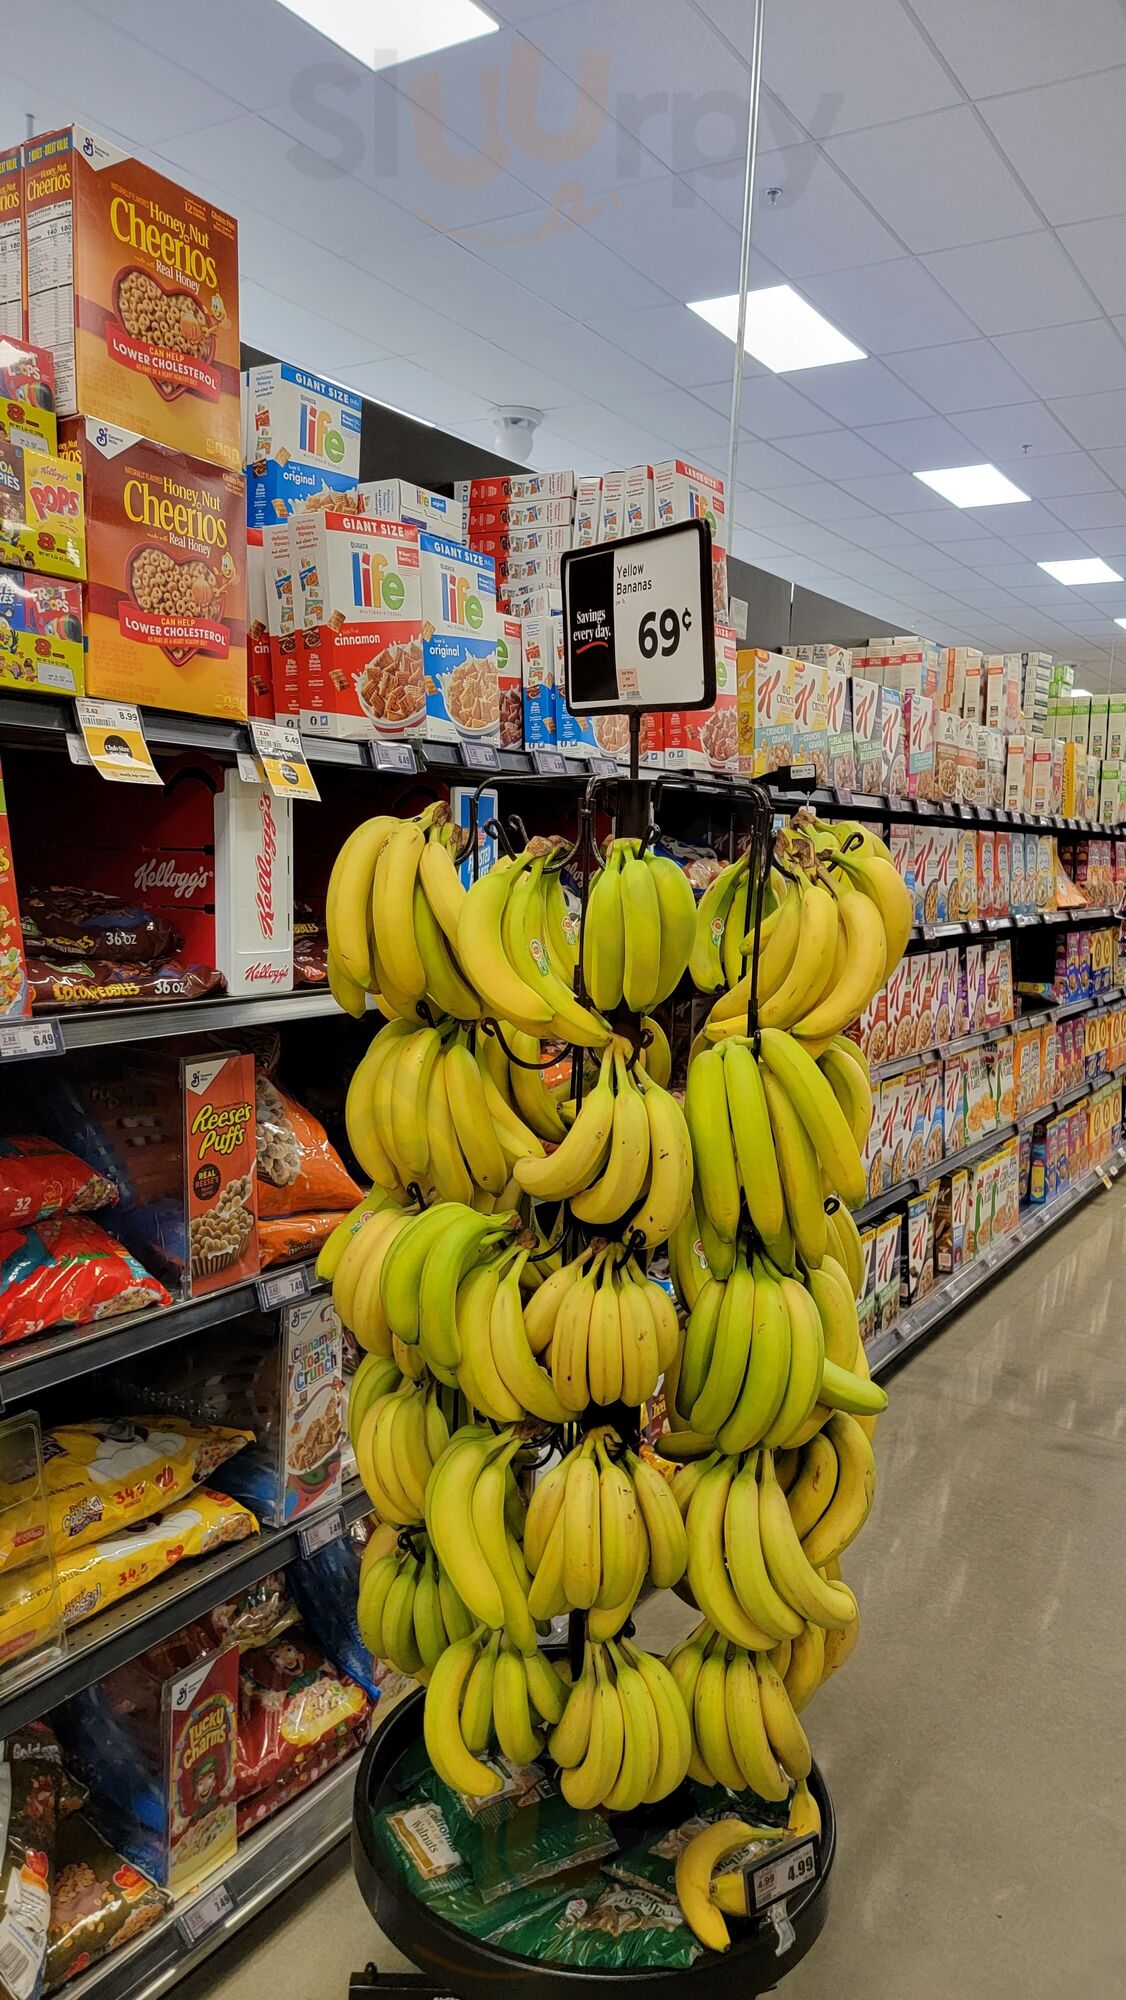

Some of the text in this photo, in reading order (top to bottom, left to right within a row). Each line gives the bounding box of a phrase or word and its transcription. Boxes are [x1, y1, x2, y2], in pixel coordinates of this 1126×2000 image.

[57, 162, 67, 174] Nut
[28, 172, 71, 202] Cheerios
[53, 200, 72, 211] Facts
[150, 200, 210, 250] Honey Nut
[110, 196, 218, 289] Cheerios
[156, 259, 200, 295] Real Honey
[112, 338, 218, 390] LOWER CHOLESTEROL
[150, 346, 185, 362] CAN HELP
[8, 363, 41, 381] LOOPS
[296, 373, 326, 394] GIANT
[328, 388, 349, 404] SIZE
[7, 402, 26, 424] 8
[300, 402, 345, 464] life
[40, 465, 70, 481] Kellogg's
[283, 470, 316, 486] original
[29, 484, 80, 522] POPS
[163, 476, 221, 512] Honey Nut
[124, 479, 228, 548] Cheerios
[37, 532, 56, 551] 8
[343, 518, 404, 538] GIANT SIZE
[169, 532, 211, 558] Real Honey
[350, 542, 369, 550] QUAKER
[434, 541, 484, 566] GIANT SIZE
[352, 551, 406, 611] life
[616, 563, 644, 579] Yellow
[440, 571, 484, 630] life
[616, 579, 652, 596] Bananas
[36, 598, 70, 614] LOOPS
[576, 608, 606, 625] Savings
[124, 617, 226, 646] LOWER CHOLESTEROL
[160, 618, 196, 627] CAN HELP
[573, 622, 612, 643] every day.
[638, 606, 692, 660] 69¢
[35, 638, 52, 658] 8
[334, 632, 381, 647] cinnamon
[429, 644, 460, 658] original
[758, 670, 781, 720] K
[794, 678, 816, 726] K
[118, 711, 138, 721] 8.99
[856, 690, 875, 740] K
[284, 735, 300, 744] 6.49
[883, 708, 899, 754] K
[913, 711, 928, 751] K
[134, 859, 208, 898] Kellogg's
[256, 790, 276, 940] Kellogg's
[106, 932, 122, 946] 36
[124, 933, 138, 946] OZ
[244, 960, 289, 985] Kellogg's
[154, 982, 186, 994] 36 OZ
[33, 1034, 54, 1046] 6.49
[924, 1079, 938, 1122] K
[946, 1071, 960, 1113] K
[191, 1104, 253, 1136] Reese's
[882, 1096, 900, 1149] K
[903, 1087, 920, 1132] K
[198, 1124, 246, 1161] Puffs
[195, 1177, 219, 1188] REESE'S
[198, 1169, 216, 1180] REAL
[14, 1196, 32, 1211] 32
[954, 1181, 966, 1223] K
[912, 1217, 927, 1260] K
[878, 1234, 896, 1283] K
[24, 1319, 44, 1334] 32
[292, 1328, 337, 1364] Cinnamon
[300, 1343, 331, 1371] Toast
[294, 1352, 338, 1392] Crunch
[69, 1496, 88, 1512] Berry
[113, 1480, 146, 1506] 34.5
[62, 1496, 104, 1532] Colossal
[118, 1562, 149, 1587] 34.5
[189, 1706, 225, 1740] Lucky
[183, 1724, 226, 1769] Charms
[412, 1820, 439, 1854] Walnuts
[787, 1856, 814, 1882] 4.99
